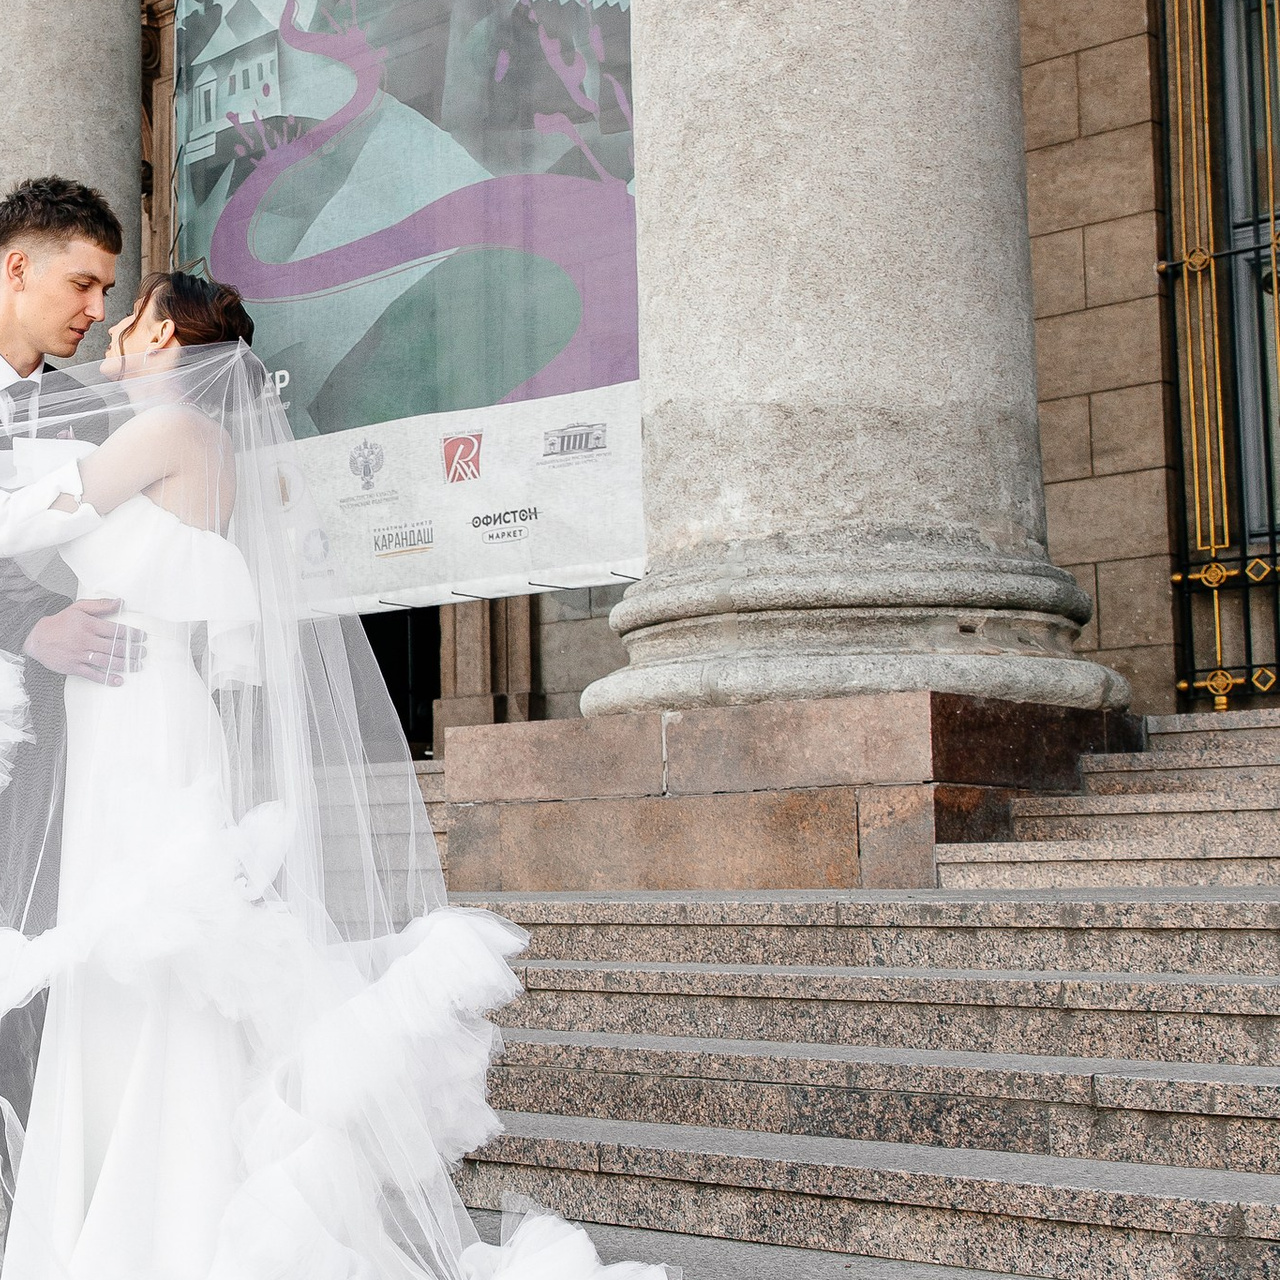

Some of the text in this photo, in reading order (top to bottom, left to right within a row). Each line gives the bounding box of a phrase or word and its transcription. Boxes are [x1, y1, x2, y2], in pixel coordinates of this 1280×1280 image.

[472, 507, 538, 528] ОФИСТОН
[373, 527, 434, 551] КАРАНДАШ
[488, 529, 523, 541] МАРКЕТ
